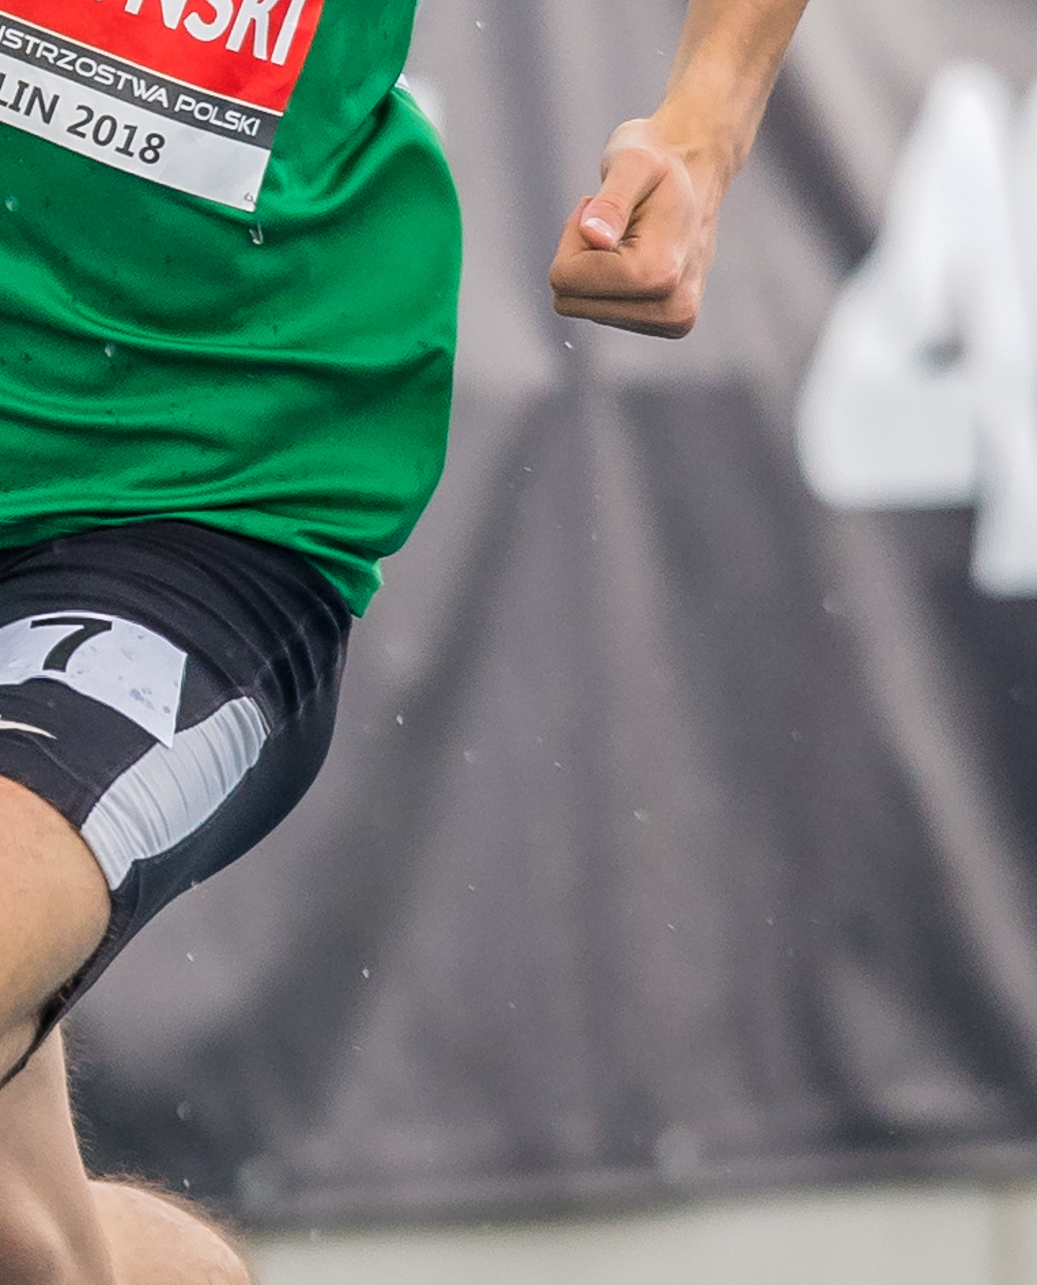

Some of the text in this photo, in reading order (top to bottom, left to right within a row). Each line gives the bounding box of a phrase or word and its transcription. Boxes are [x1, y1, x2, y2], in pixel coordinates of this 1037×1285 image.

[66, 104, 166, 164] 2018
[174, 94, 261, 137] POLSKI
[29, 616, 113, 674] 7
